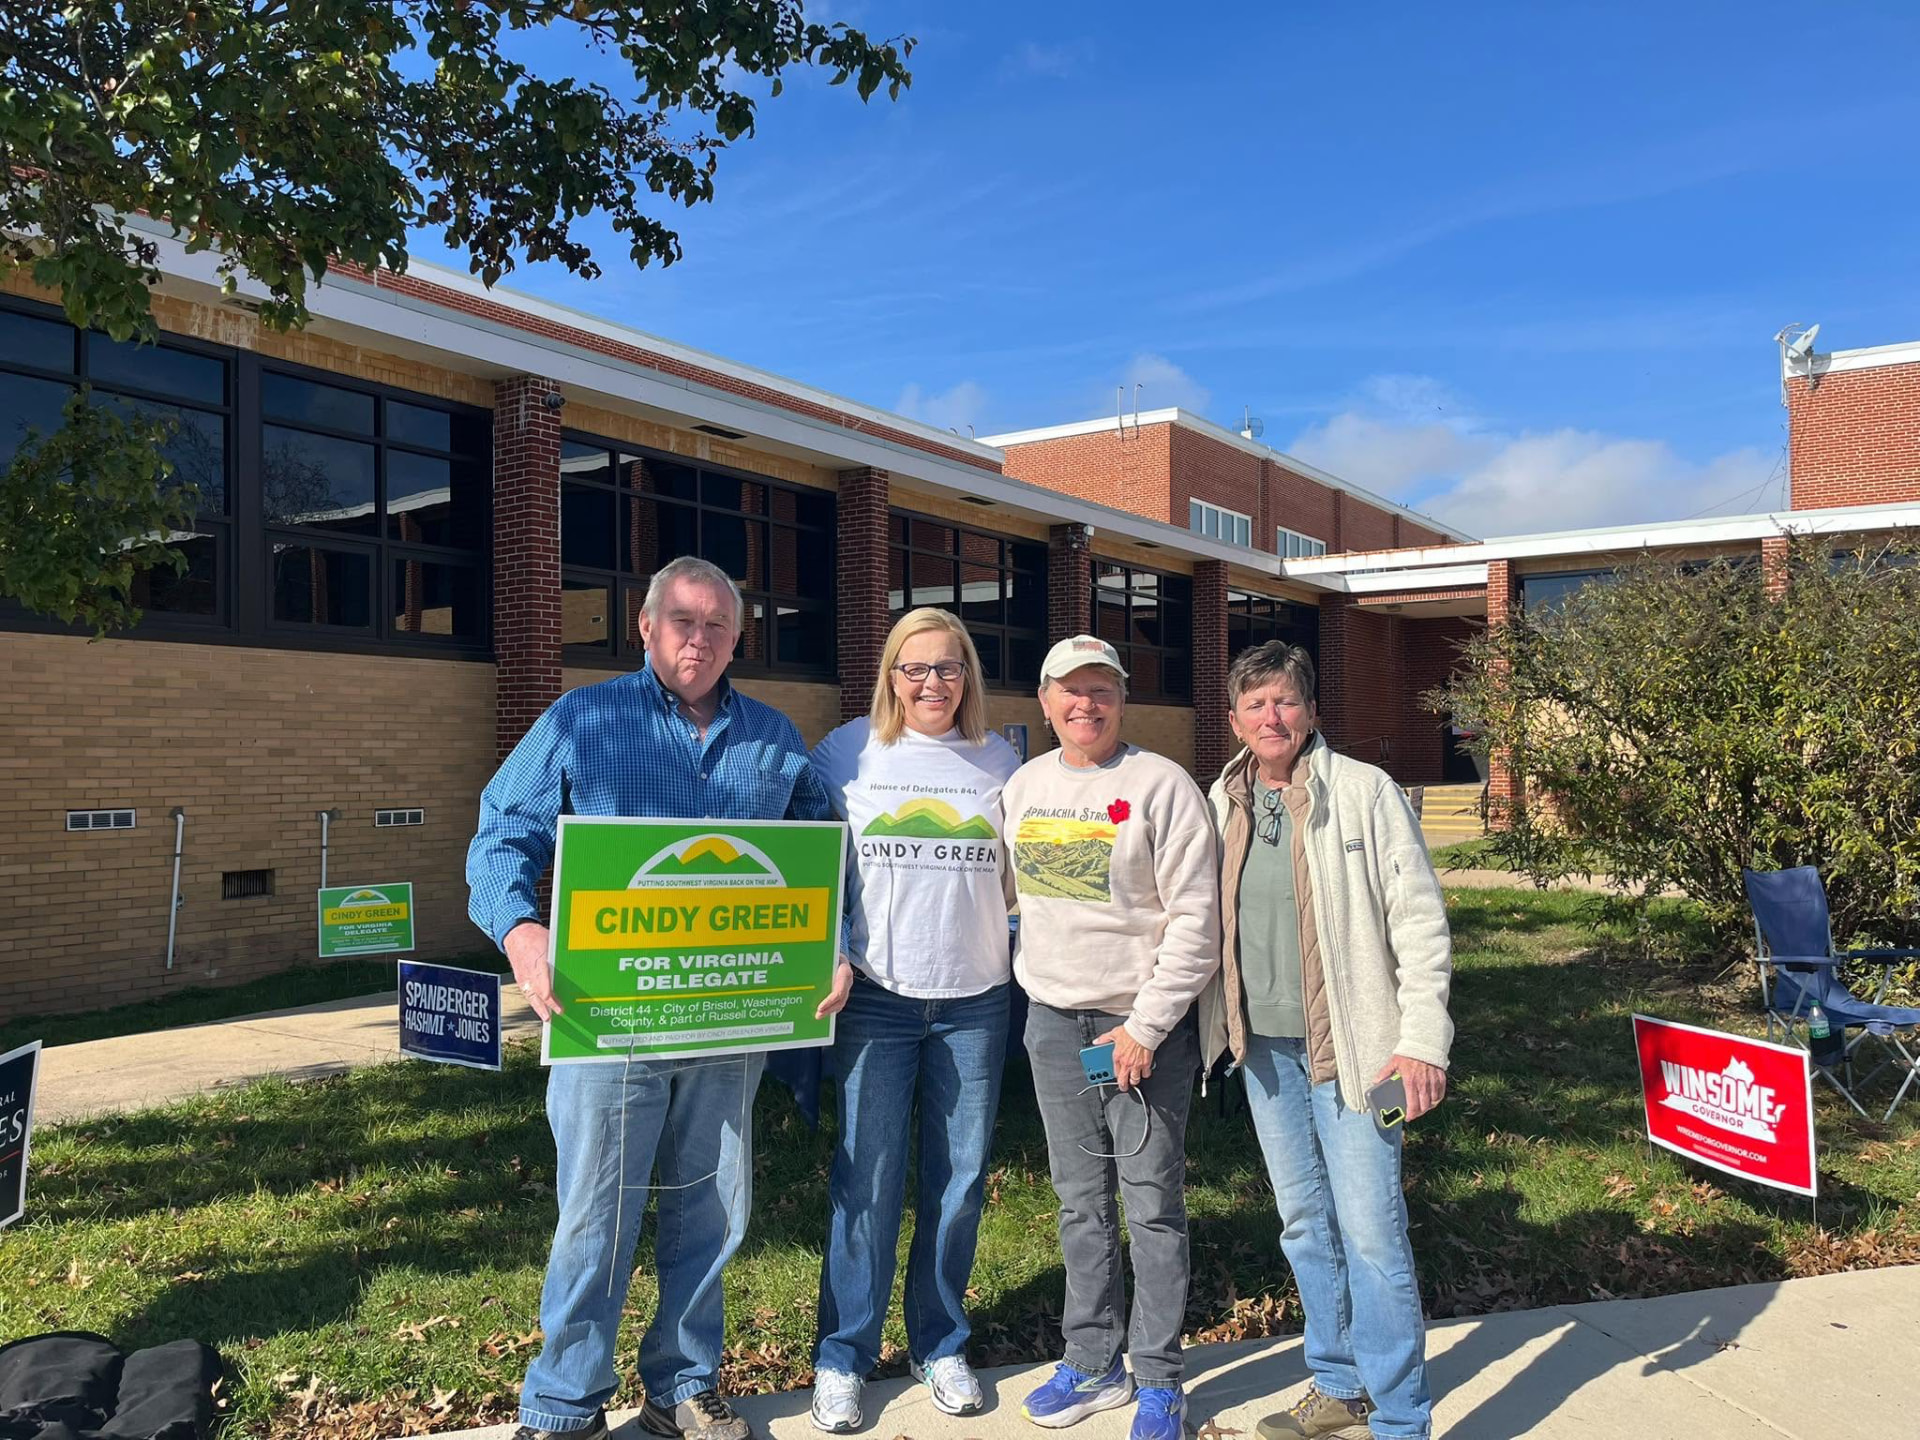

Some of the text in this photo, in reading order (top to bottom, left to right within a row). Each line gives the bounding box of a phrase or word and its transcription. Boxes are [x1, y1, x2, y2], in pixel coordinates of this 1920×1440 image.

[870, 783, 977, 795] House of Delegates #44
[1080, 808, 1111, 822] STRO
[862, 843, 997, 863] CINDY GREEN
[331, 908, 400, 921] CINDY GREEN
[595, 903, 810, 934] CINDY GREEN
[344, 928, 388, 936] DELEGATE
[618, 951, 784, 971] FOR VIRGINIA
[637, 970, 768, 990] DELEGATE
[405, 981, 489, 1019] SPANBERGER
[590, 1006, 633, 1017] District
[636, 1005, 651, 1014] 44
[663, 1003, 686, 1015] City
[688, 1002, 700, 1012] of
[702, 999, 739, 1012] Bristol,
[742, 996, 803, 1008] Washington
[405, 1009, 490, 1044] HASHMI JONES
[611, 1008, 785, 1029] County, & part of Russell County
[1660, 1060, 1776, 1123] WINSOME
[1692, 1105, 1744, 1129] GOVERNOR
